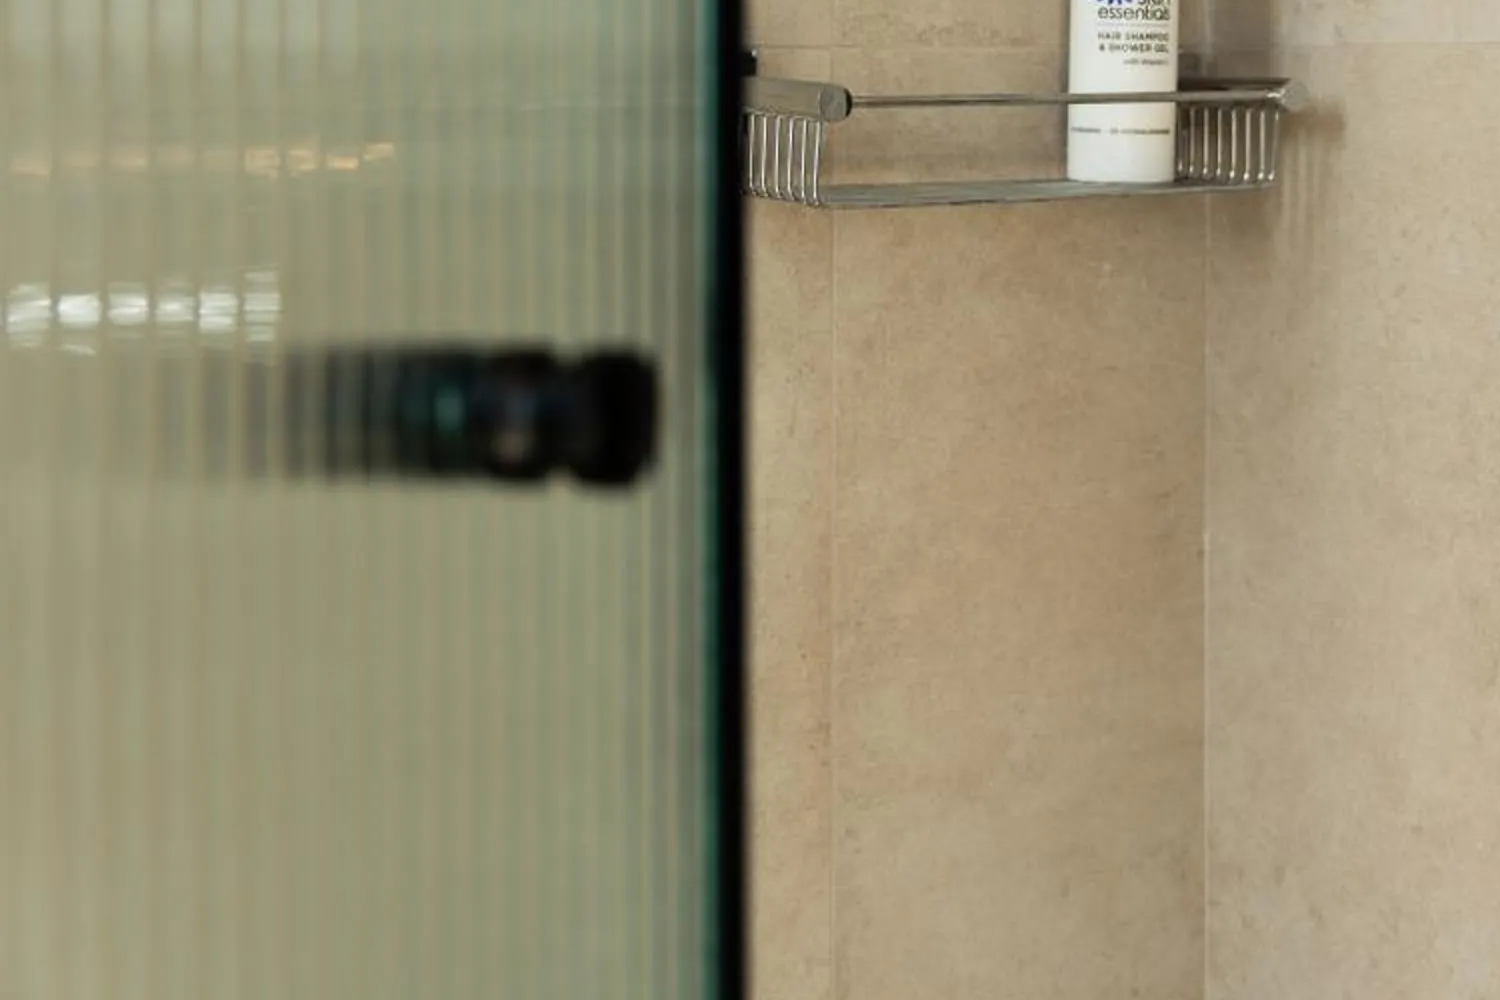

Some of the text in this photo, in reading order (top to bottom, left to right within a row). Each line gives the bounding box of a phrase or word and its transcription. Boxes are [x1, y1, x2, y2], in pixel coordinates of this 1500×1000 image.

[1097, 5, 1171, 21] essentials
[1097, 31, 1170, 42] HAIR SHAMPOO
[1108, 43, 1152, 54] SHOWER
